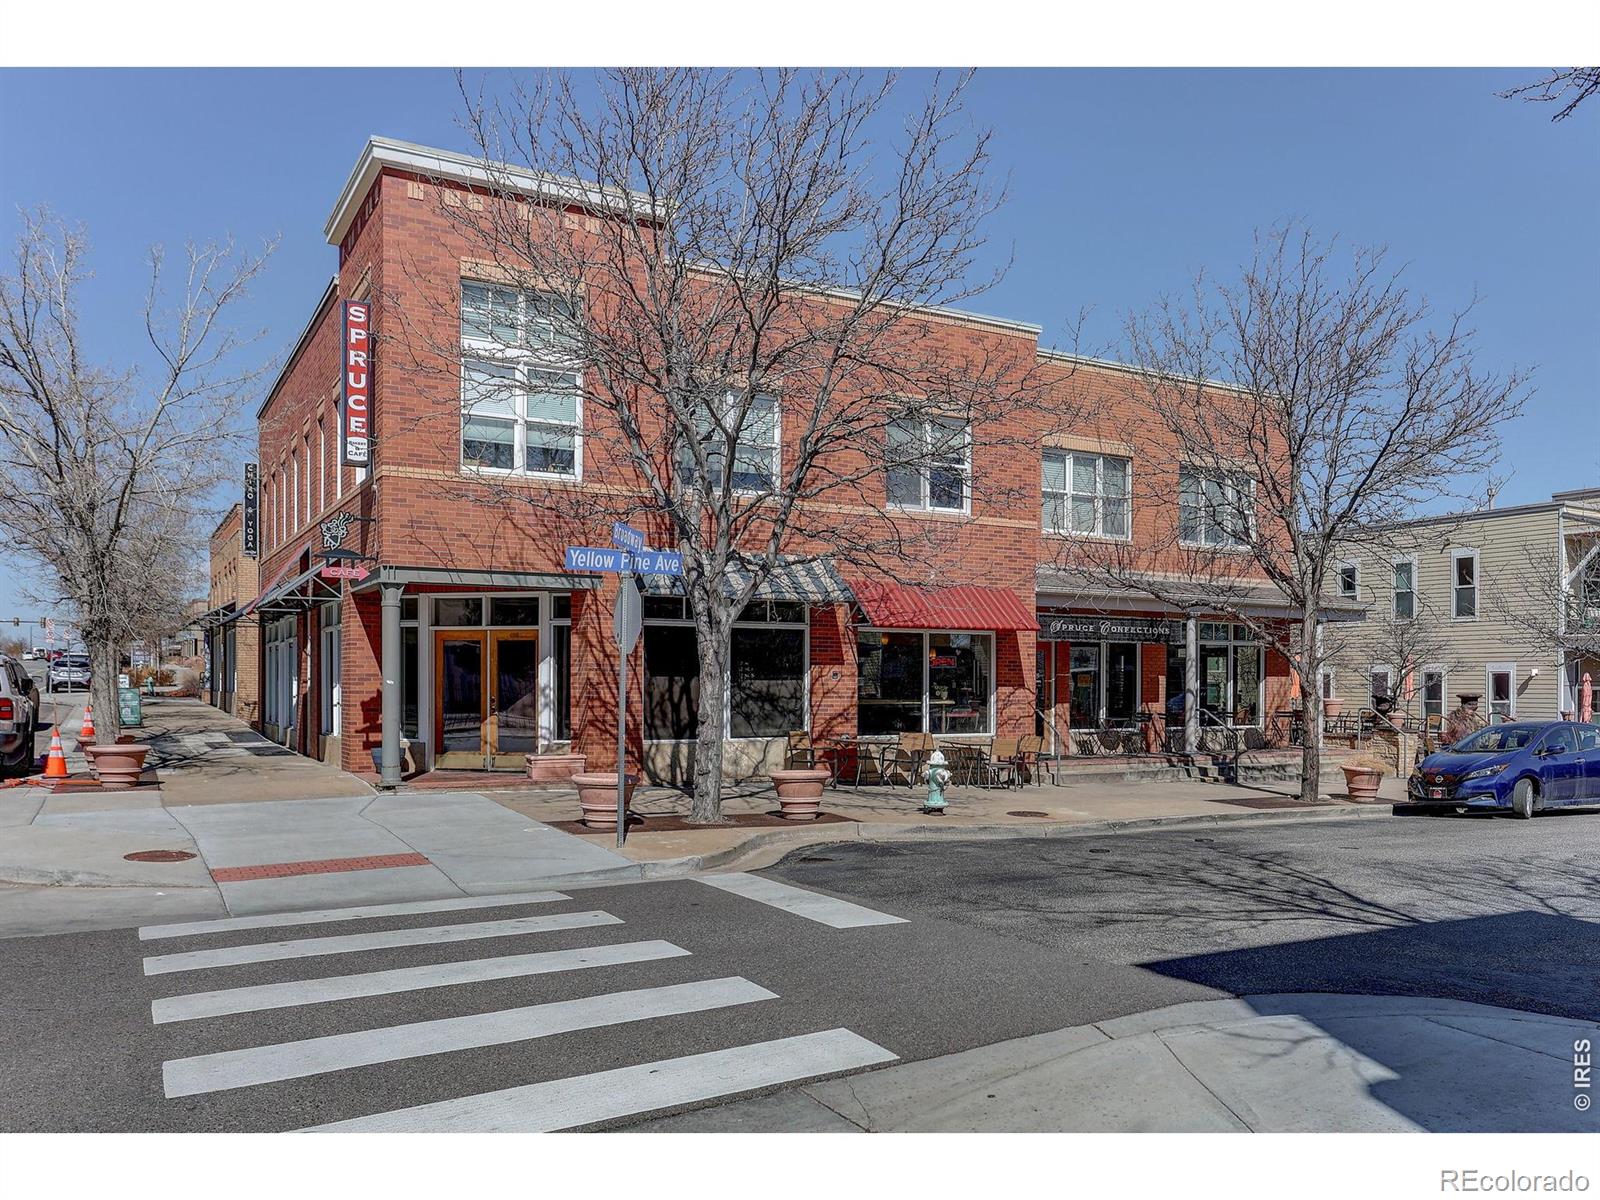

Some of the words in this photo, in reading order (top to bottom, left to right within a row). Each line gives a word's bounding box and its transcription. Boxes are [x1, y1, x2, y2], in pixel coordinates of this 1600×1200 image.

[347, 306, 367, 433] SPRUCE
[613, 522, 643, 553] Broadway
[570, 549, 614, 569] Yellow
[620, 552, 650, 570] Pine
[654, 555, 679, 572] Ave
